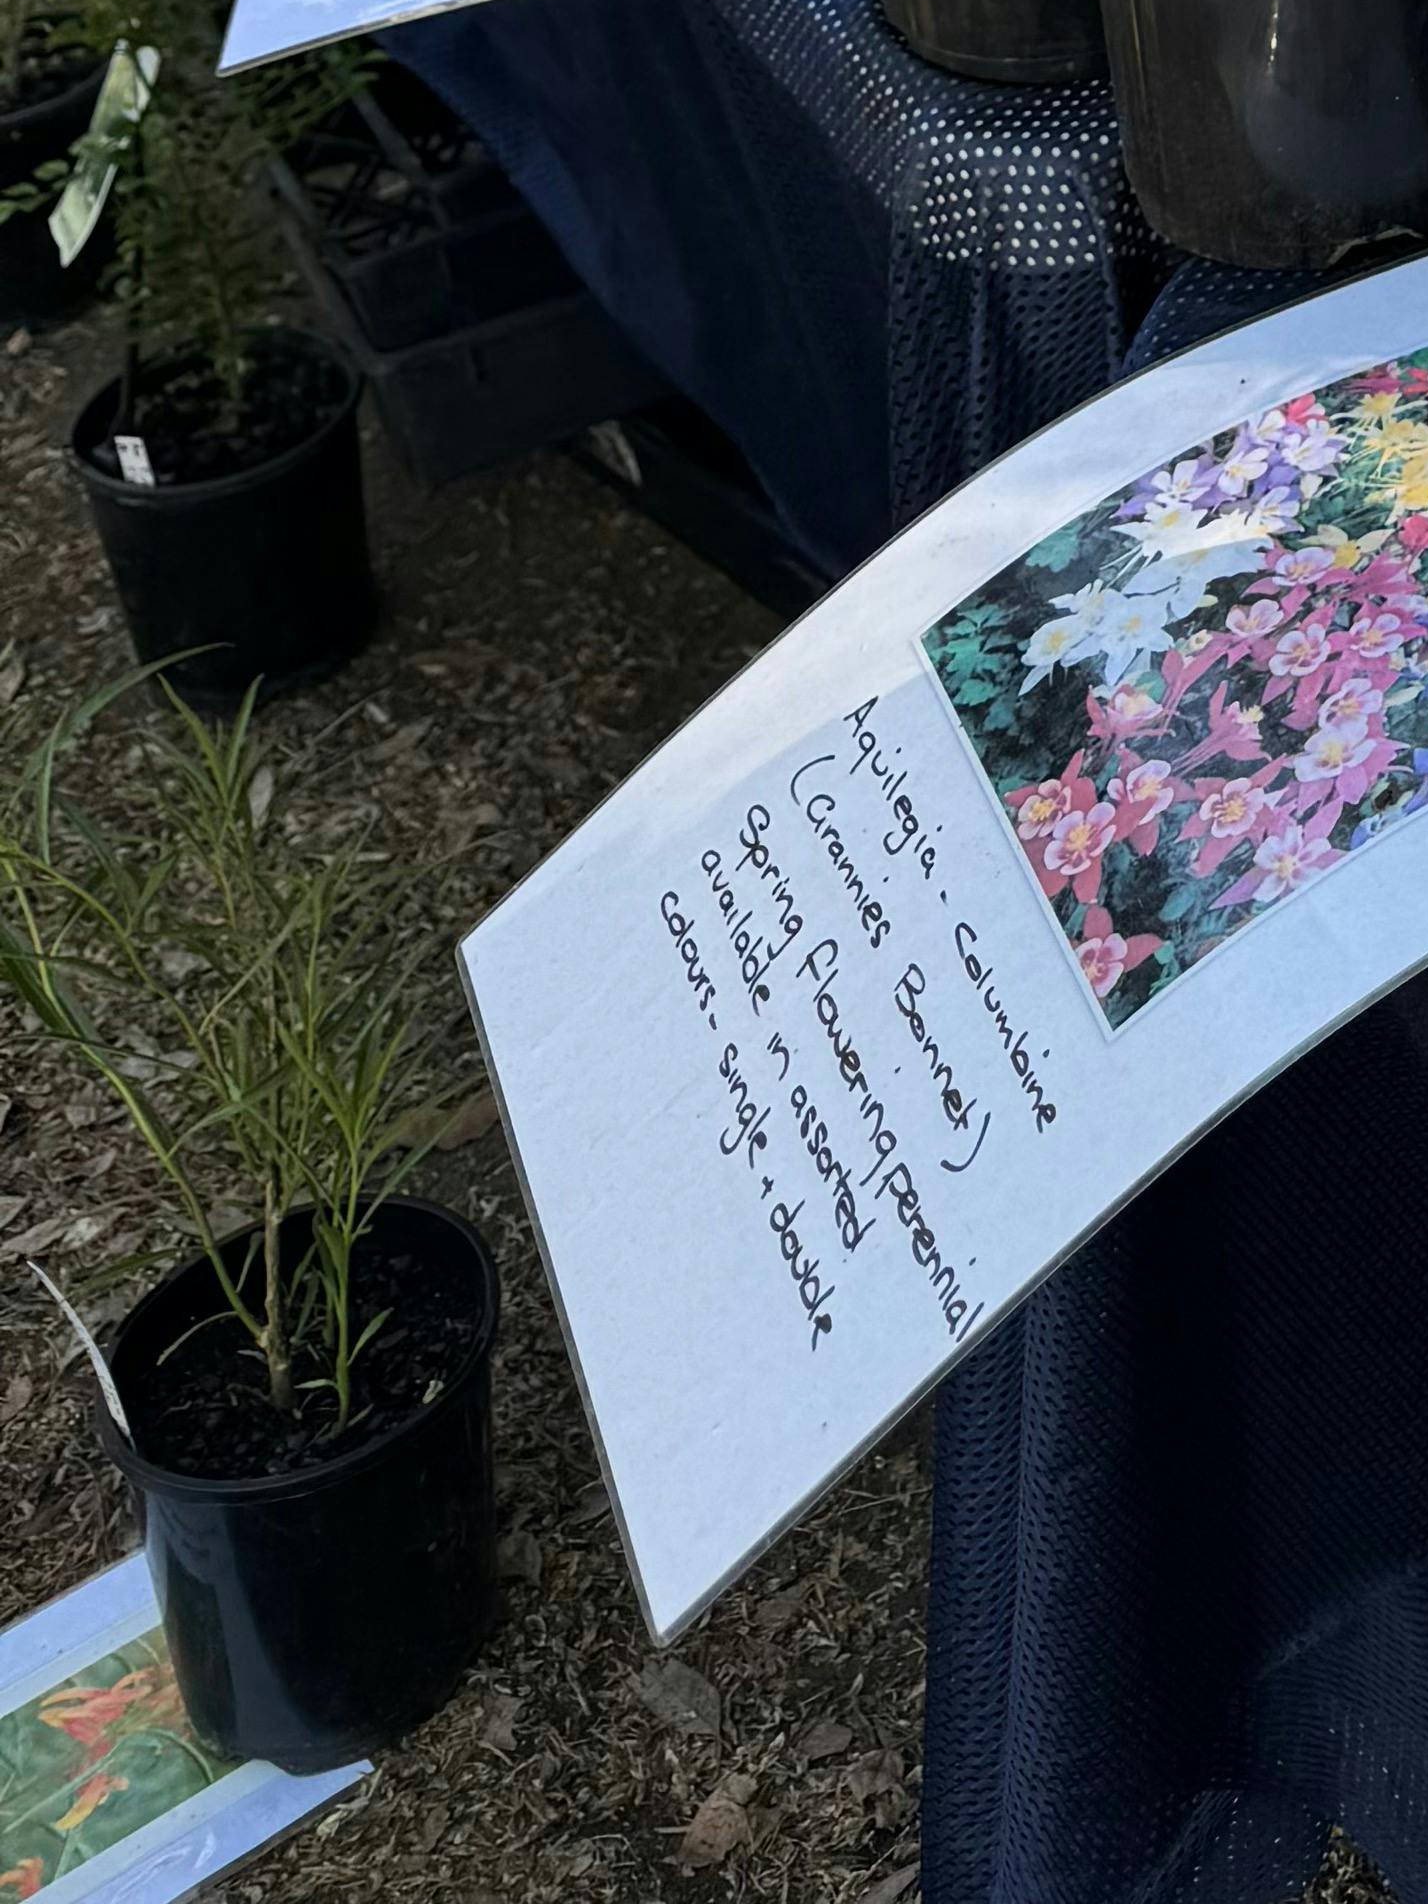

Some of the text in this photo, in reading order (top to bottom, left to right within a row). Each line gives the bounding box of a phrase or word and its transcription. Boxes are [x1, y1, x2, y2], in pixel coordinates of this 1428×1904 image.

[738, 802, 804, 962] Spring
[842, 694, 939, 881] Aquilegia
[699, 848, 772, 1019] available
[766, 1030, 792, 1082] in
[715, 1041, 770, 1174] single
[765, 1199, 838, 1353] double
